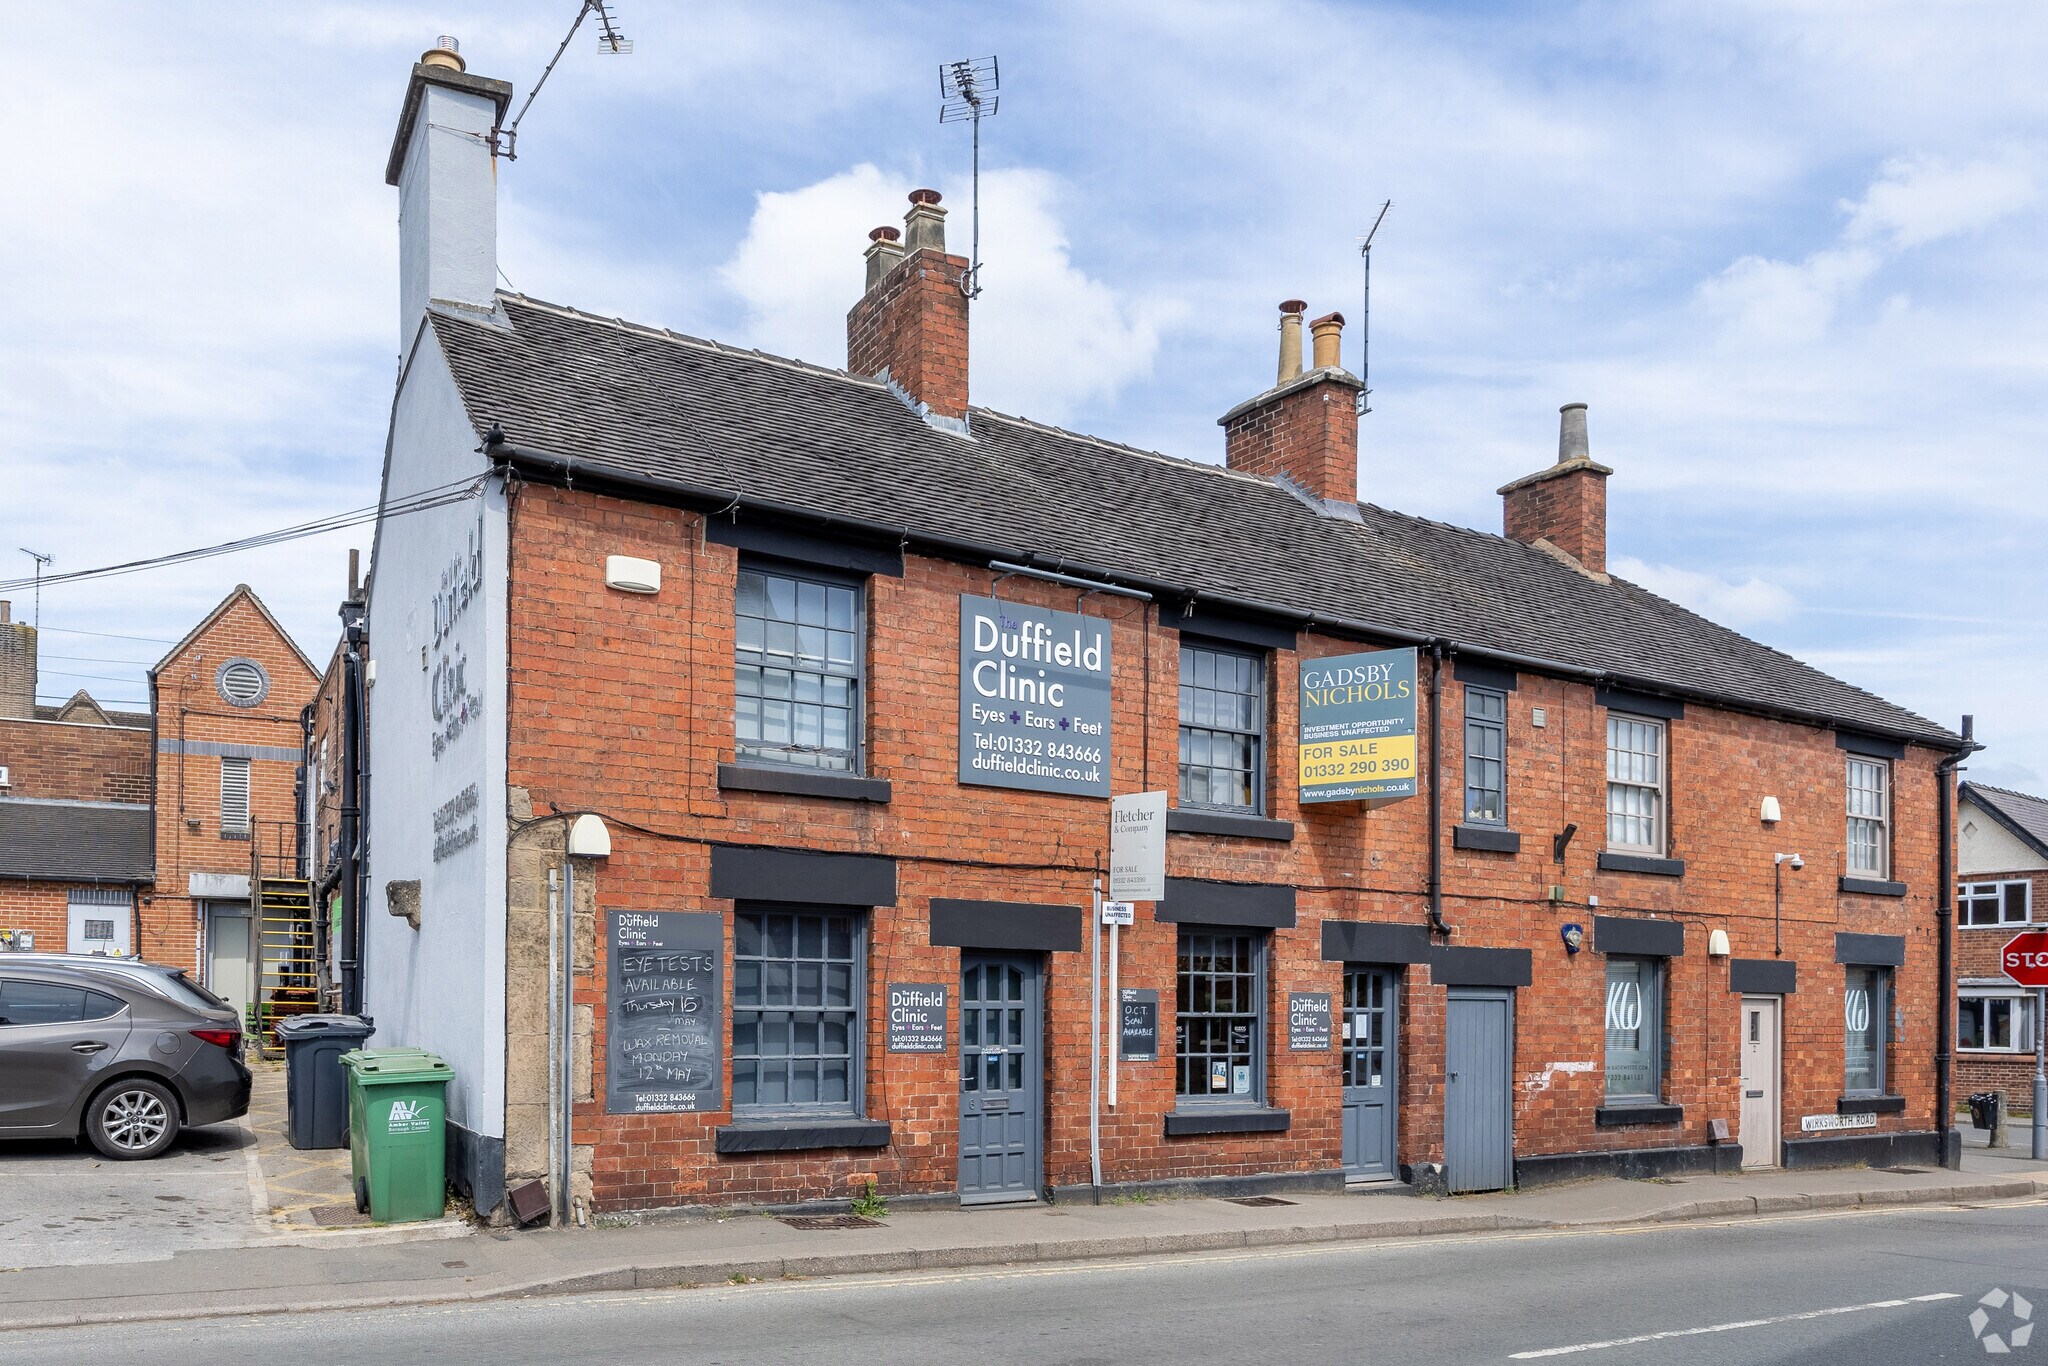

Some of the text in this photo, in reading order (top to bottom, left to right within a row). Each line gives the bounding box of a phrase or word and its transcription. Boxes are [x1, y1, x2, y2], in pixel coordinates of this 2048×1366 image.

[999, 615, 1018, 629] The
[974, 615, 1102, 671] Duffield
[1304, 662, 1395, 690] GADSBY
[972, 660, 1064, 708] Clinic
[1305, 680, 1410, 708] NICHOLS
[972, 703, 1102, 736] Eyes Ears Feet
[1304, 718, 1405, 733] INVESTMENT OPPORTUNITY
[1304, 726, 1390, 740] BUSINESS UNAFFECTED
[973, 733, 1101, 764] Tel:01332 843666
[1303, 743, 1378, 760] FOR SALE
[972, 752, 1101, 783] duffieldclinic.co.uk
[1304, 758, 1410, 778] 01332 290 390
[1304, 783, 1410, 797] www.gadsbynichols.co.uk
[1114, 809, 1155, 824] Fletcher
[1114, 824, 1149, 834] & Company
[1113, 866, 1124, 874] FOR
[619, 914, 659, 928] Duffield
[618, 927, 647, 940] Clinic
[623, 955, 714, 973] EYE TESTS
[2006, 952, 2048, 968] STO
[624, 978, 698, 994] AVAILABLE
[622, 995, 698, 1013] Thursday 15
[892, 991, 943, 1007] Duffield
[1291, 998, 1328, 1012] Duffield
[891, 1007, 928, 1023] Clinic
[1291, 1013, 1318, 1026] Clinic
[891, 1024, 905, 1032] Eyes
[623, 1033, 708, 1052] WAX REMOVAL
[891, 1042, 942, 1050] duffieldclinic.co.uk
[632, 1051, 688, 1066] MONDAY
[635, 1093, 696, 1103] Tel:01332 843666
[969, 1098, 976, 1110] 6
[635, 1102, 696, 1112] duffieldclinic.co.uk
[1805, 1114, 1875, 1129] WIRKSWORTH ROAD
